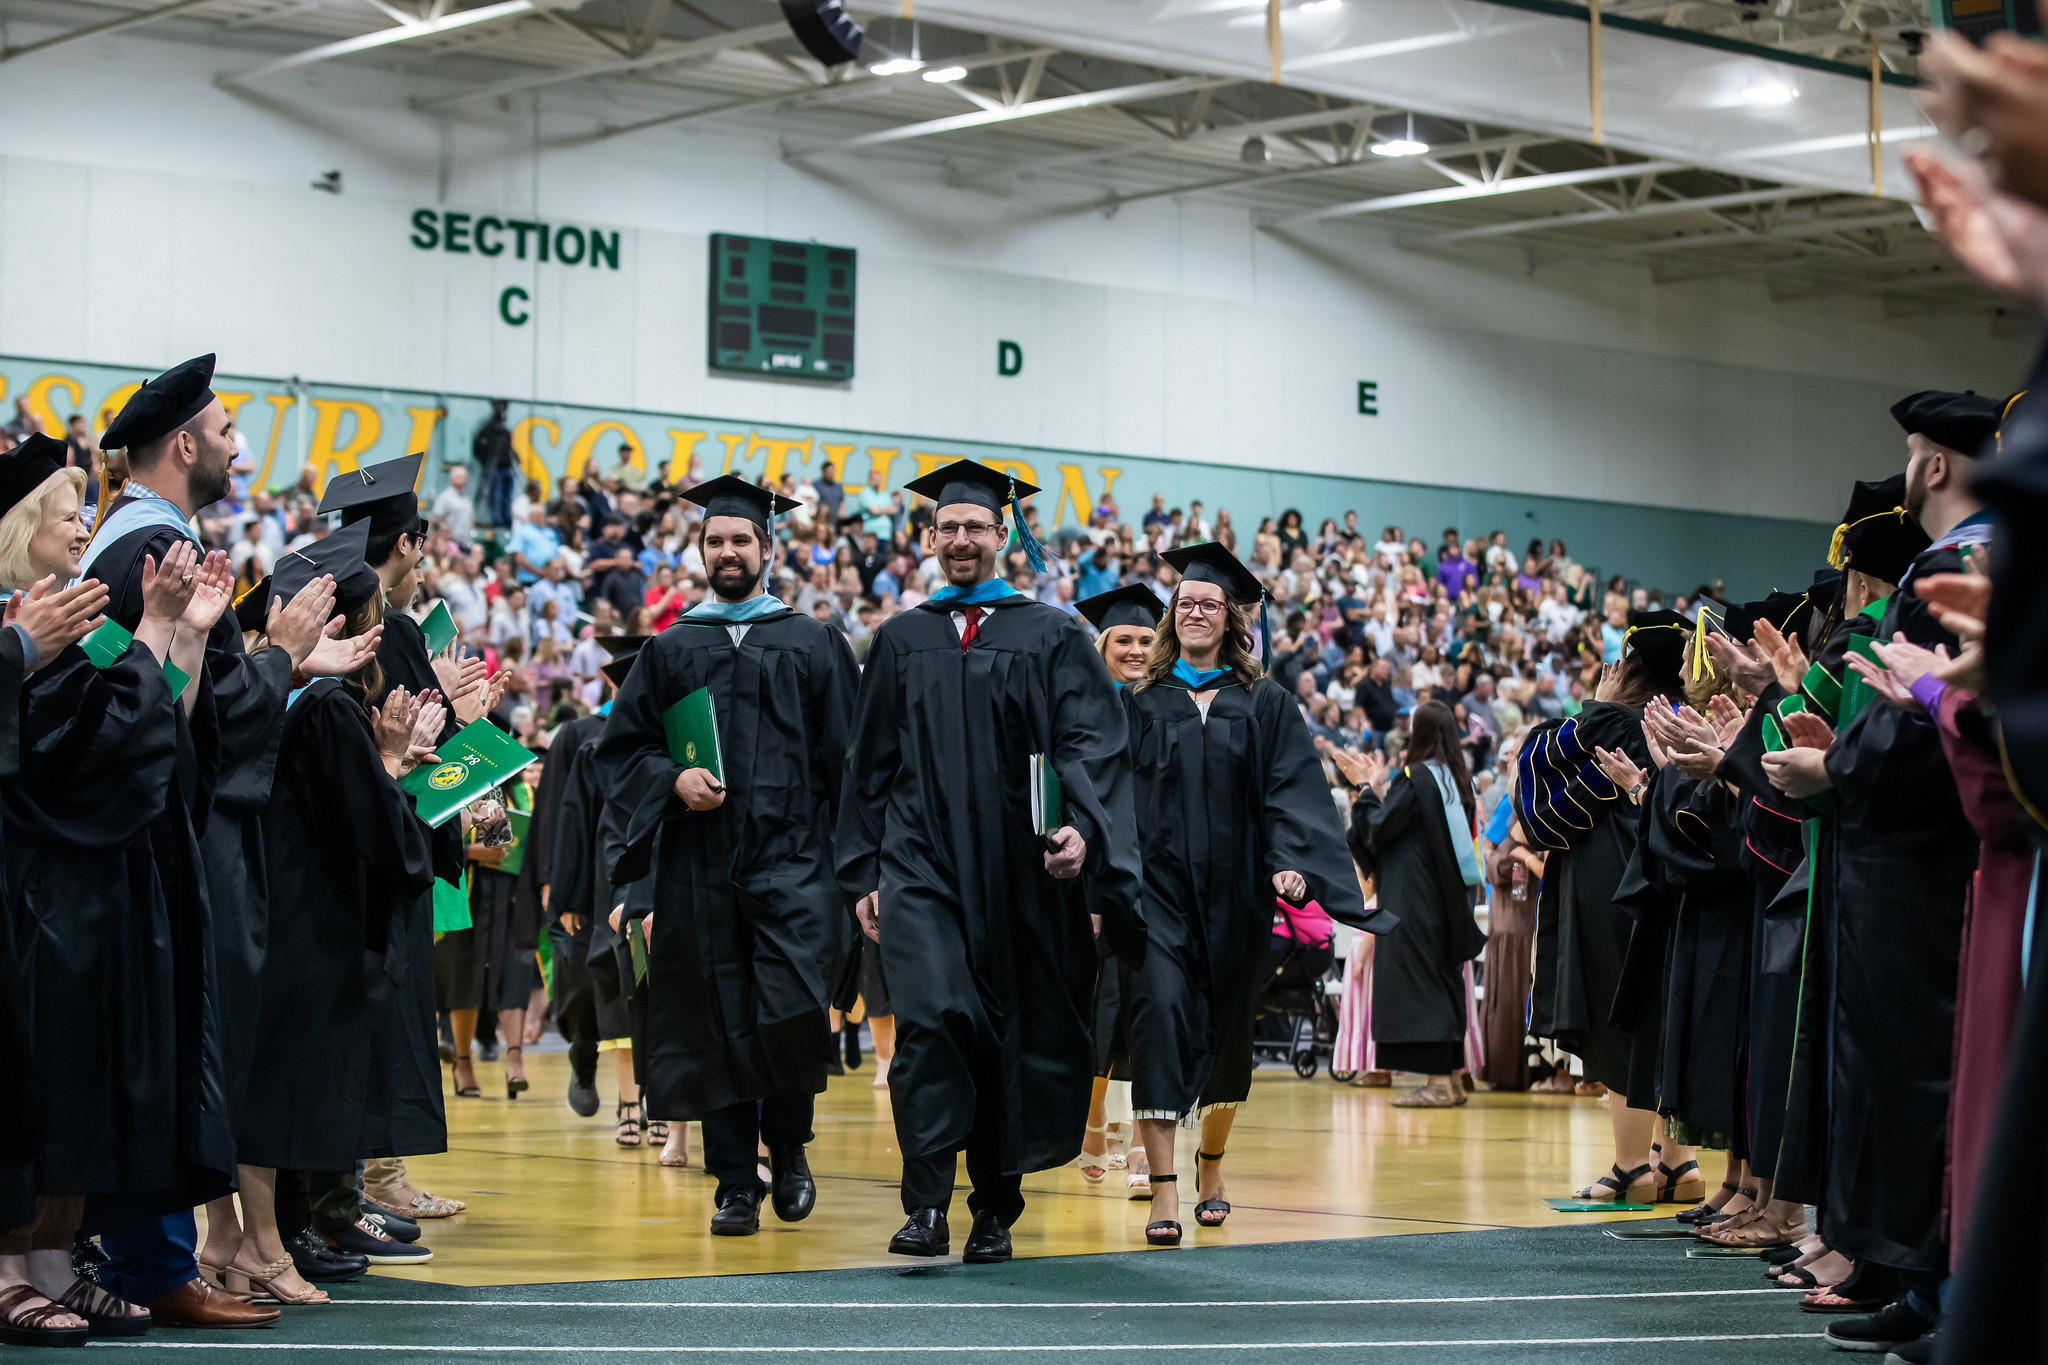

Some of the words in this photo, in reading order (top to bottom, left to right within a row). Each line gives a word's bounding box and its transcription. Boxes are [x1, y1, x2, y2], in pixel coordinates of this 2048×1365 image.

[411, 209, 619, 270] SECTION
[500, 286, 529, 326] C
[998, 340, 1023, 377] D
[1357, 381, 1379, 416] E
